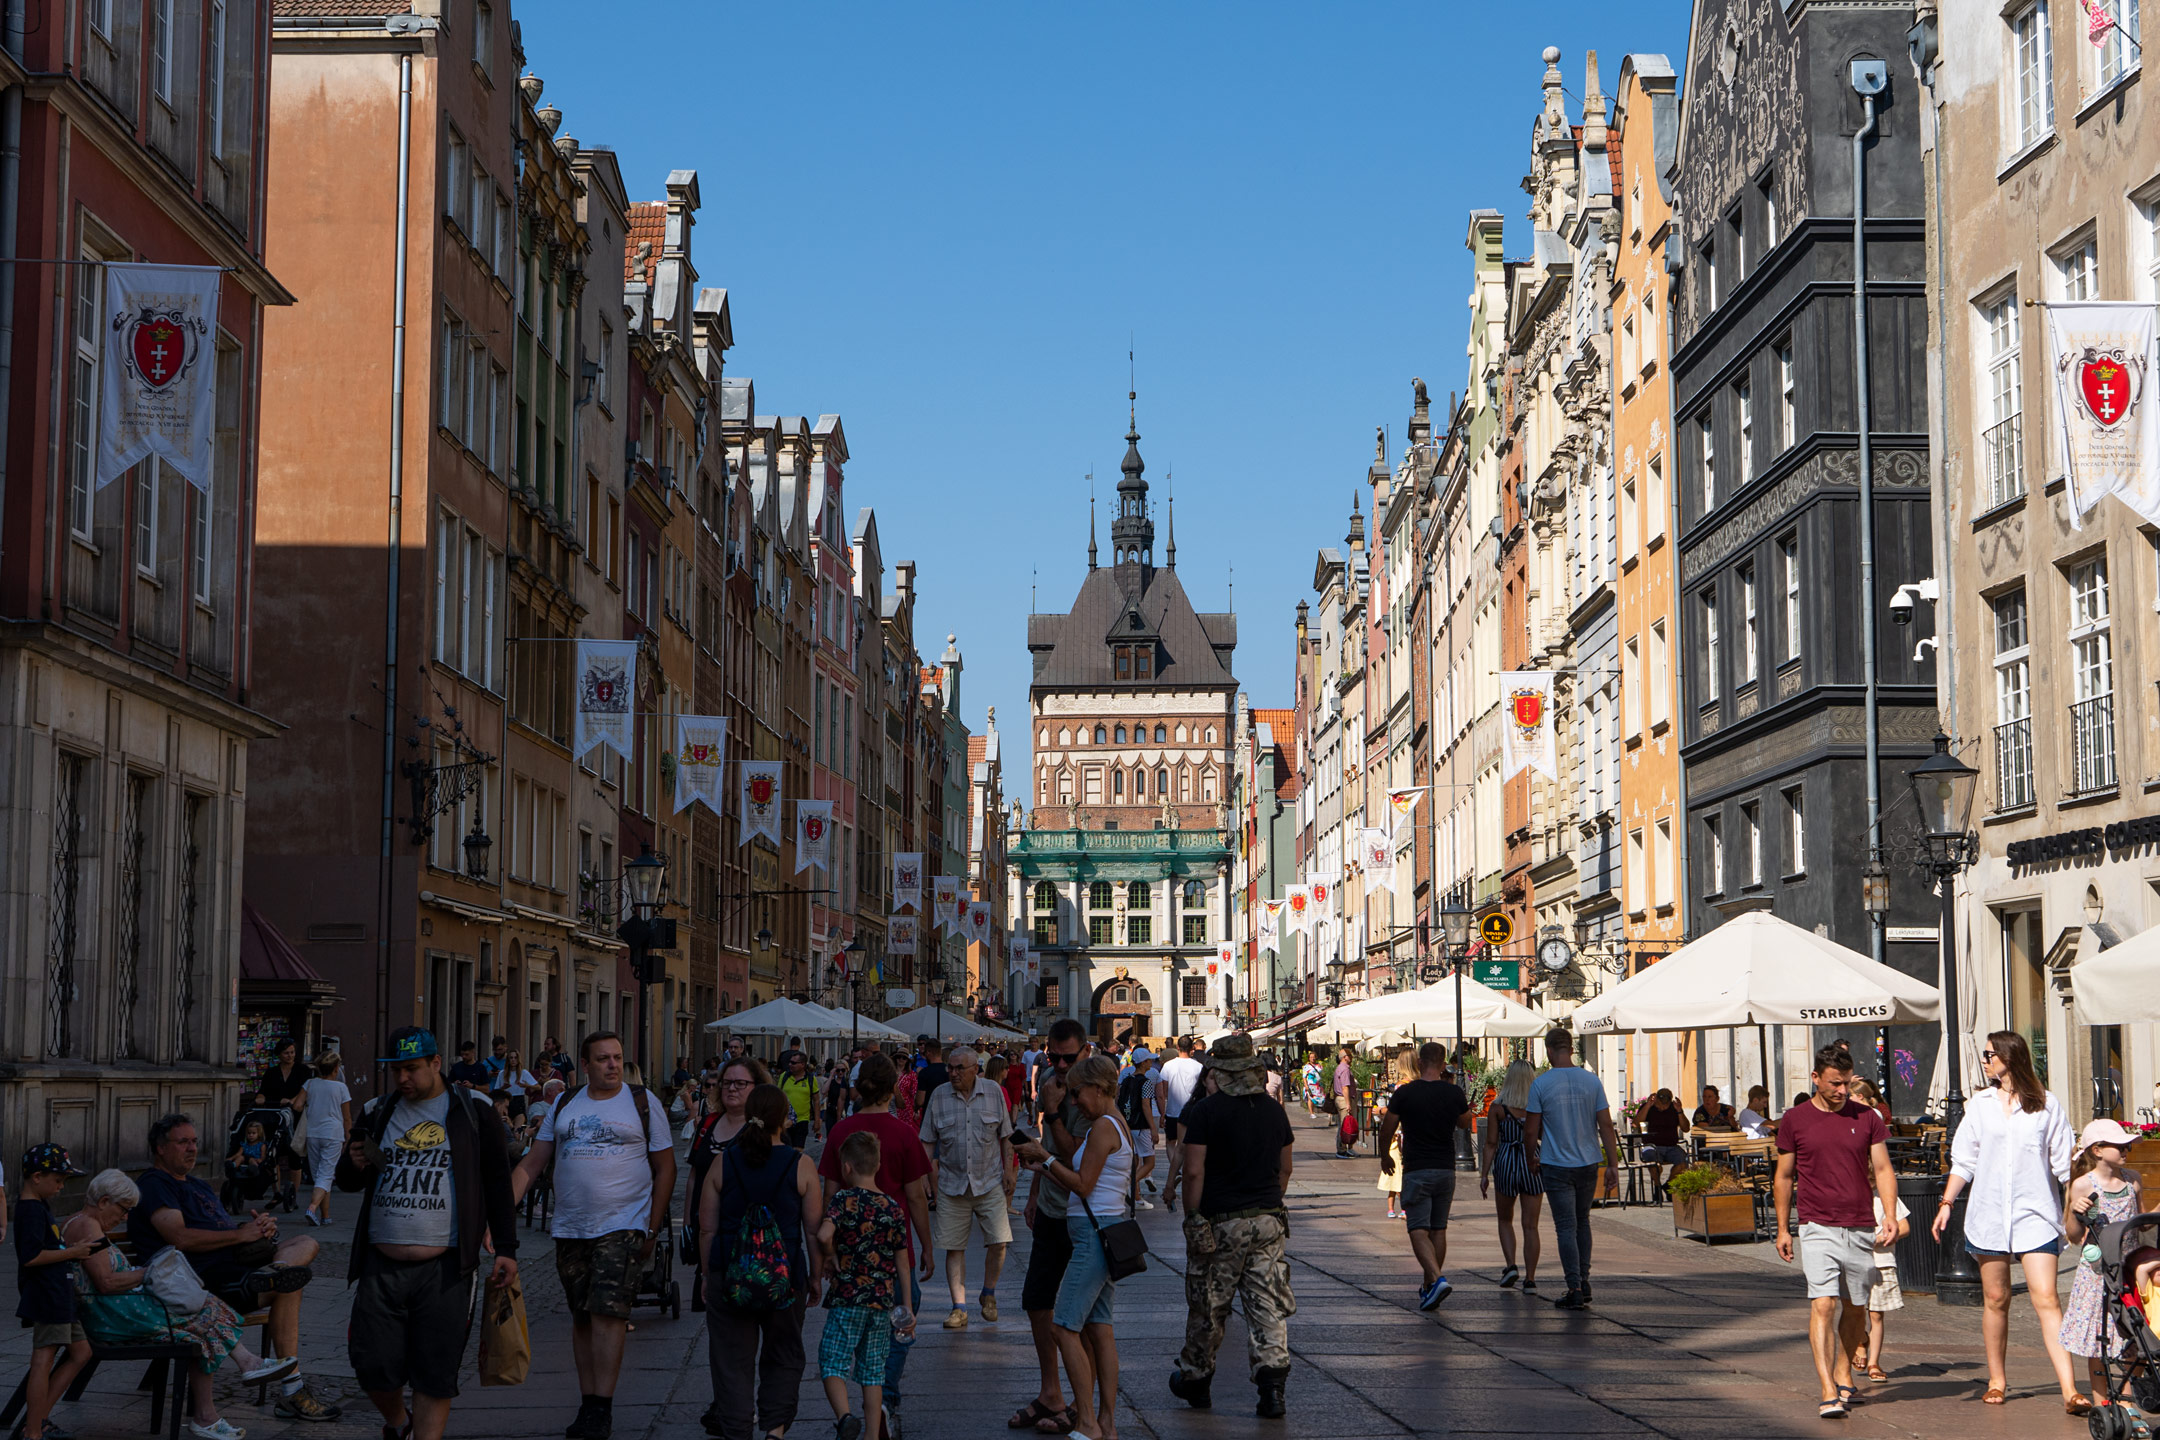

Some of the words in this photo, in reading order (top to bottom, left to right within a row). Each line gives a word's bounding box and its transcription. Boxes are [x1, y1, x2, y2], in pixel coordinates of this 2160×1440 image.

[2007, 826, 2105, 868] STARBUCKS
[1426, 968, 1443, 977] Lody
[1800, 1005, 1887, 1019] STARBUCKS
[1583, 1015, 1613, 1030] STARBUCKS
[379, 1165, 444, 1196] PANI
